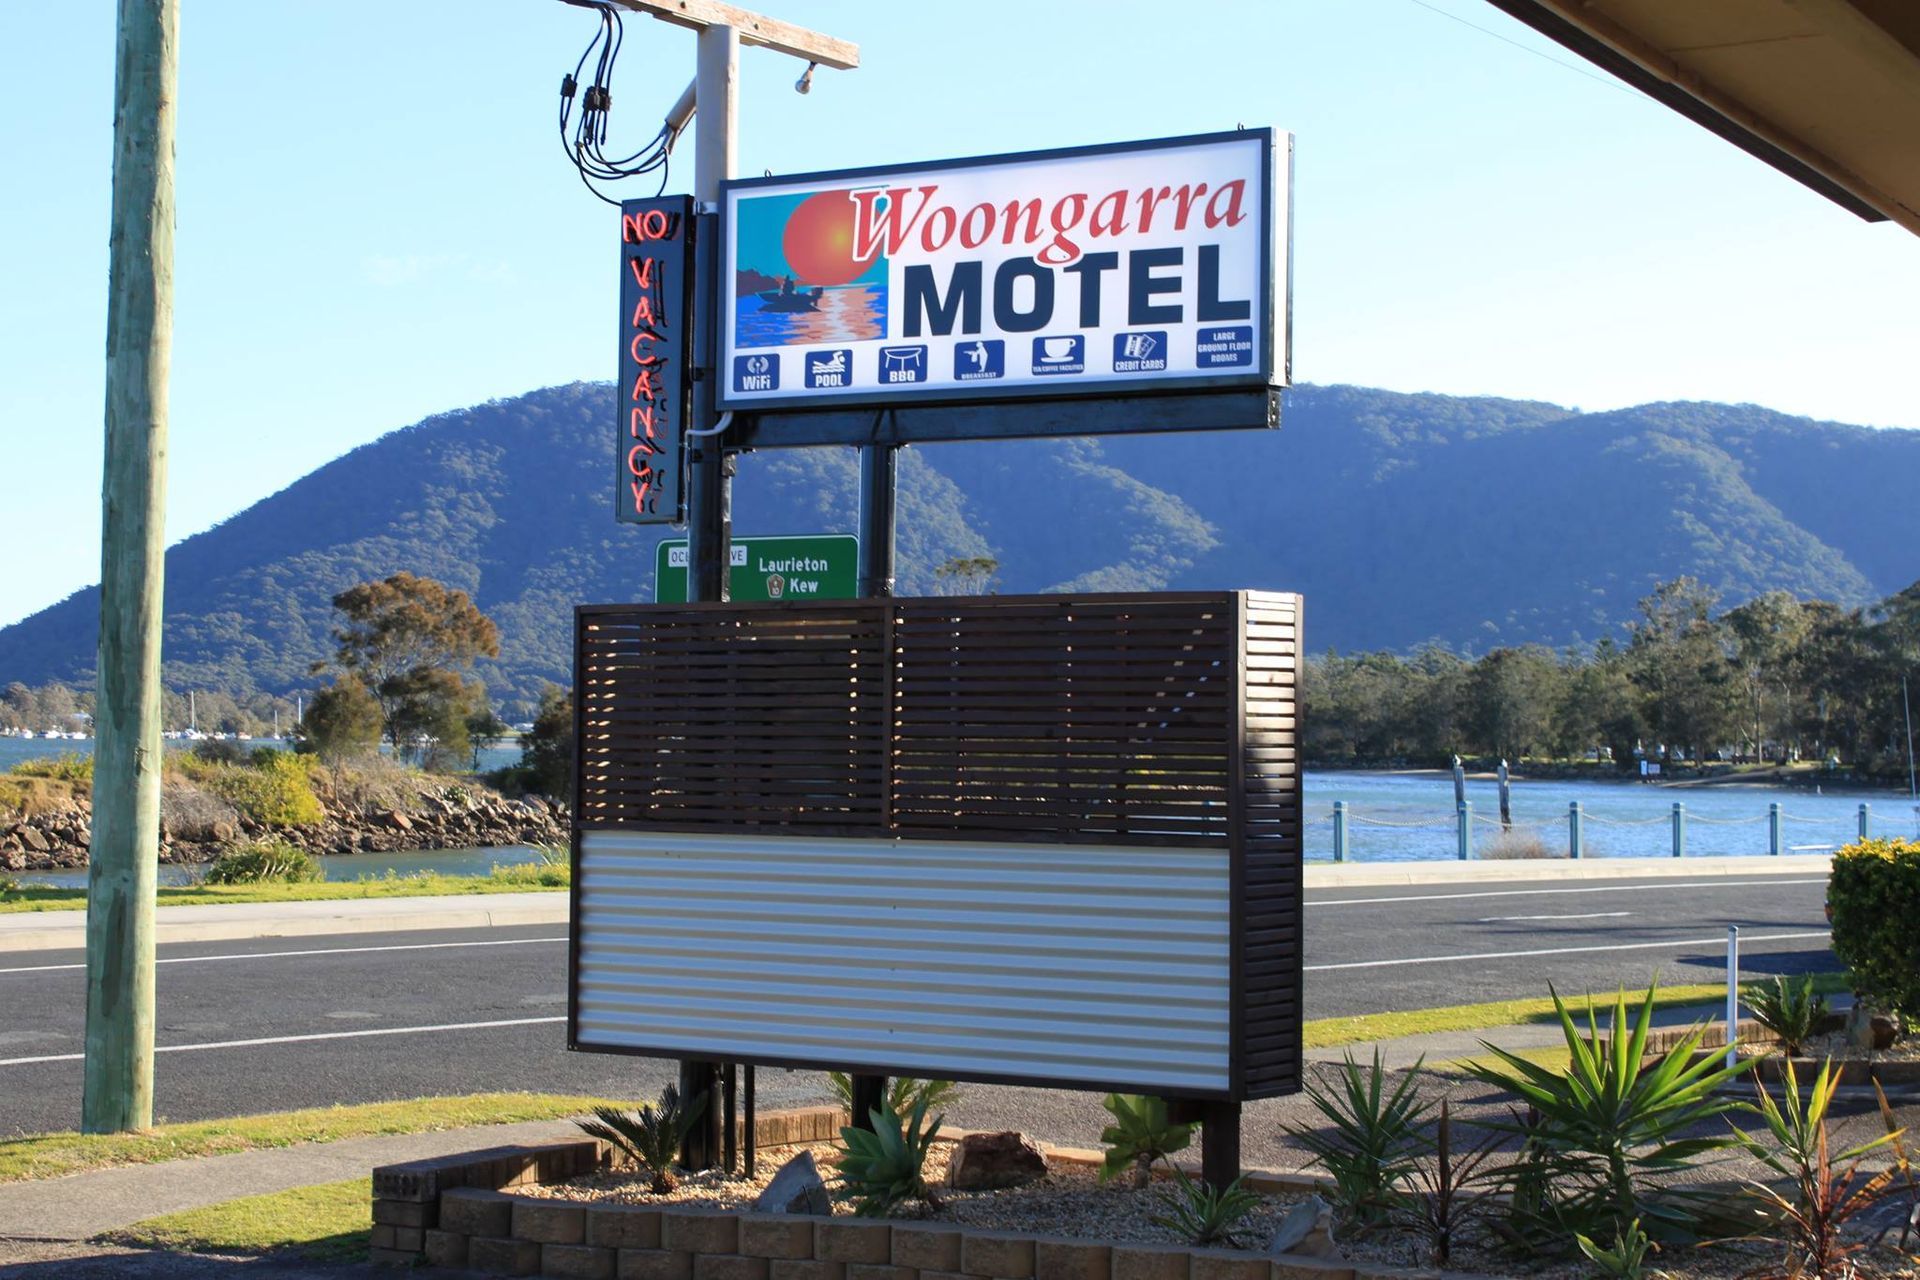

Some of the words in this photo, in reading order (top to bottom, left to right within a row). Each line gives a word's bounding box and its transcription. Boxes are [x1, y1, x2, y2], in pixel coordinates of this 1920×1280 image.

[622, 209, 669, 243] NO
[850, 177, 1248, 265] Woongarra
[903, 244, 1252, 338] MOTEL
[1213, 331, 1236, 341] LARGE
[1197, 342, 1228, 353] GROUND
[1229, 341, 1252, 351] FLOOR
[1115, 360, 1140, 371] CREDIT
[1140, 359, 1165, 370] CARDS
[1210, 353, 1238, 363] ROOMS
[742, 375, 771, 391] WiFi
[815, 373, 844, 388] POOL
[889, 370, 916, 382] BBQ
[961, 372, 997, 380] BREAKFAST
[627, 256, 657, 514] VACANCY
[759, 557, 828, 573] Laurieton
[790, 577, 819, 593] Kew
